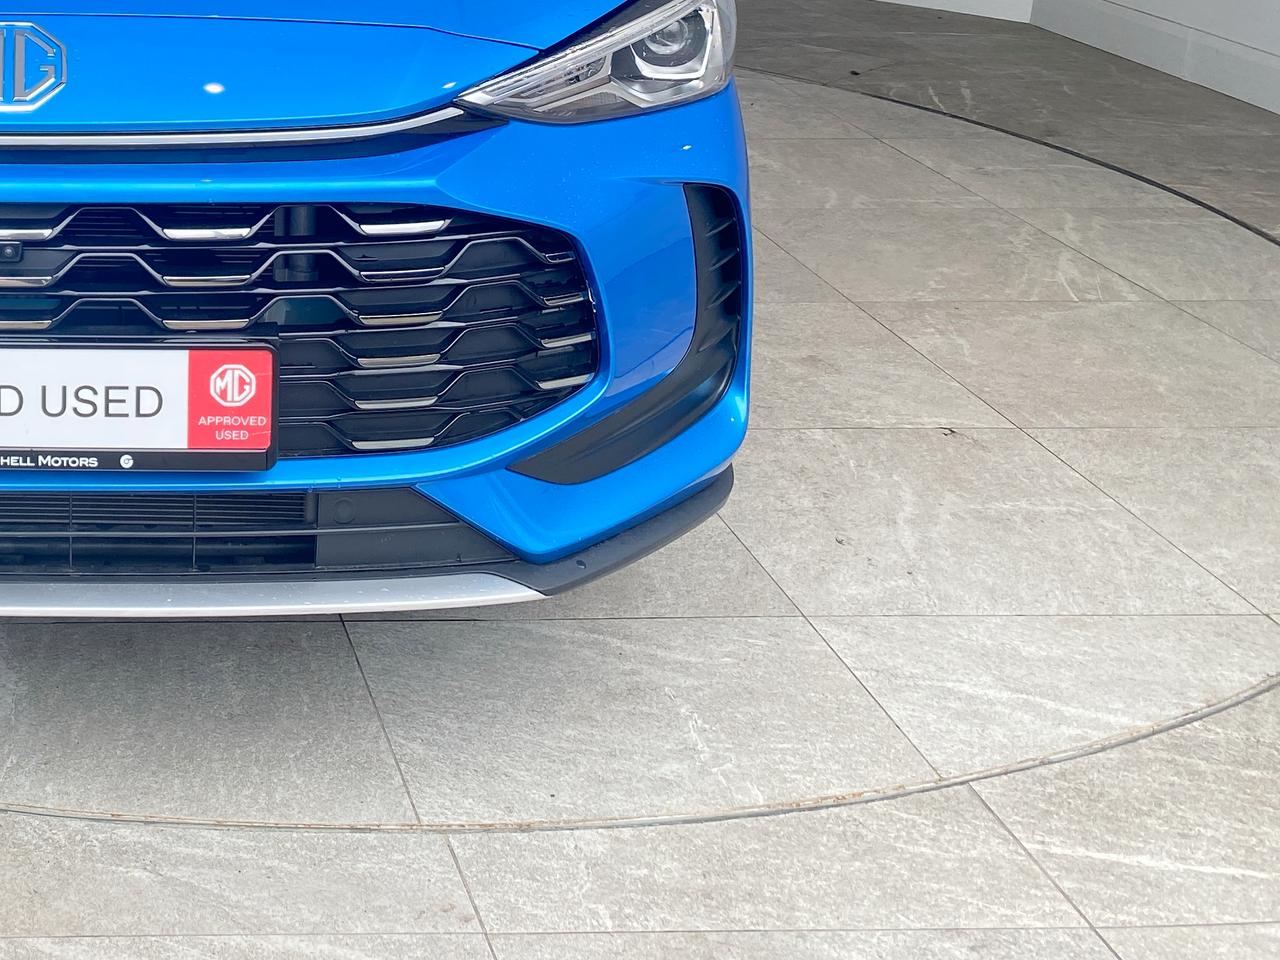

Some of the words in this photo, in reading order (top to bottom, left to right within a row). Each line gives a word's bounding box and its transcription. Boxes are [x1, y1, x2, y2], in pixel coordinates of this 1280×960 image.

[213, 367, 252, 403] MG
[40, 384, 164, 419] USED
[198, 415, 267, 427] APPROVED
[215, 429, 250, 441] USED
[38, 455, 99, 468] MOTORS
